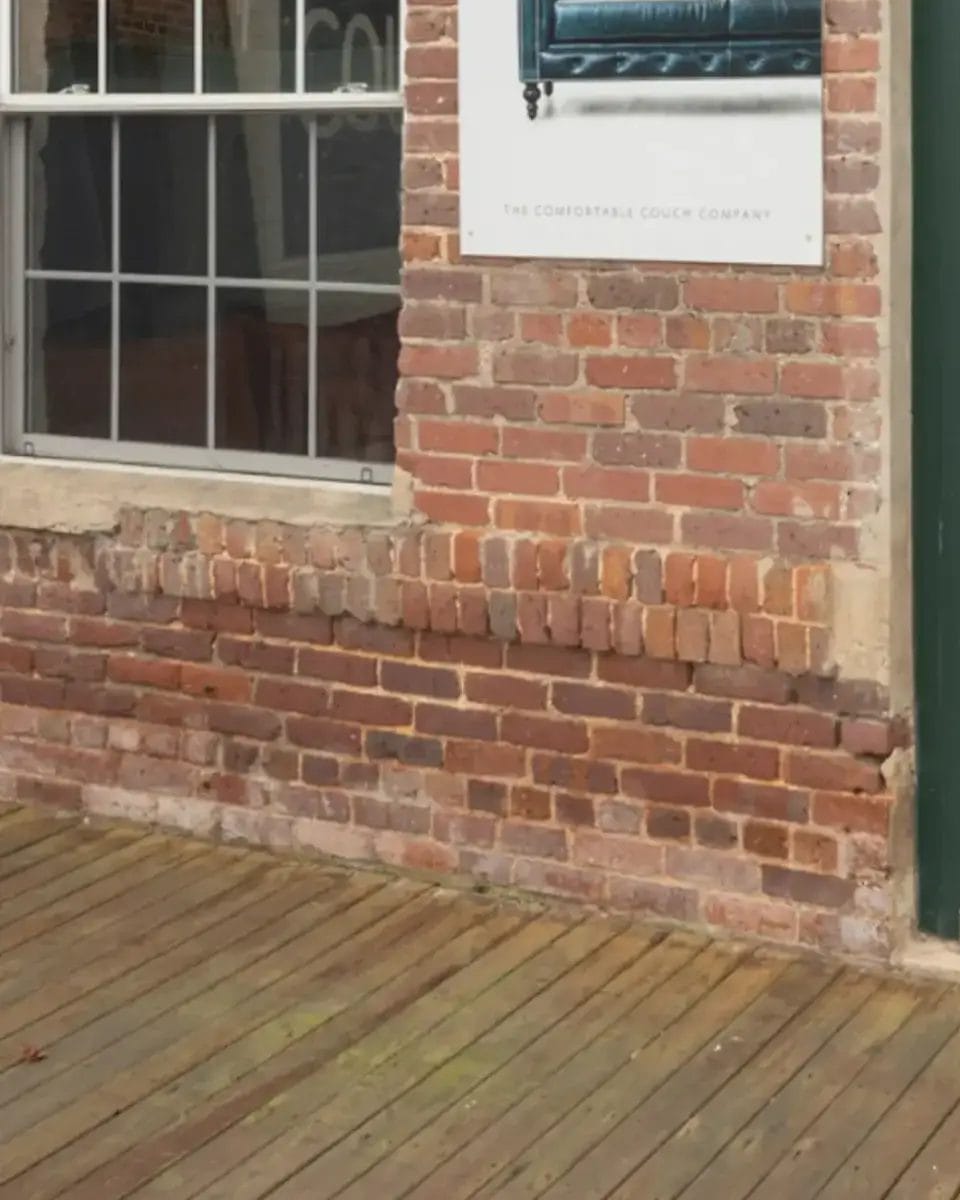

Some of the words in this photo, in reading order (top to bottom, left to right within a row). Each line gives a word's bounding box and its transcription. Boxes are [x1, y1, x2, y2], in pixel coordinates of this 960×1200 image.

[503, 203, 529, 217] THE
[534, 203, 634, 220] COMFORTABLE
[640, 205, 692, 220] COUCH
[699, 206, 772, 222] COMPANY
